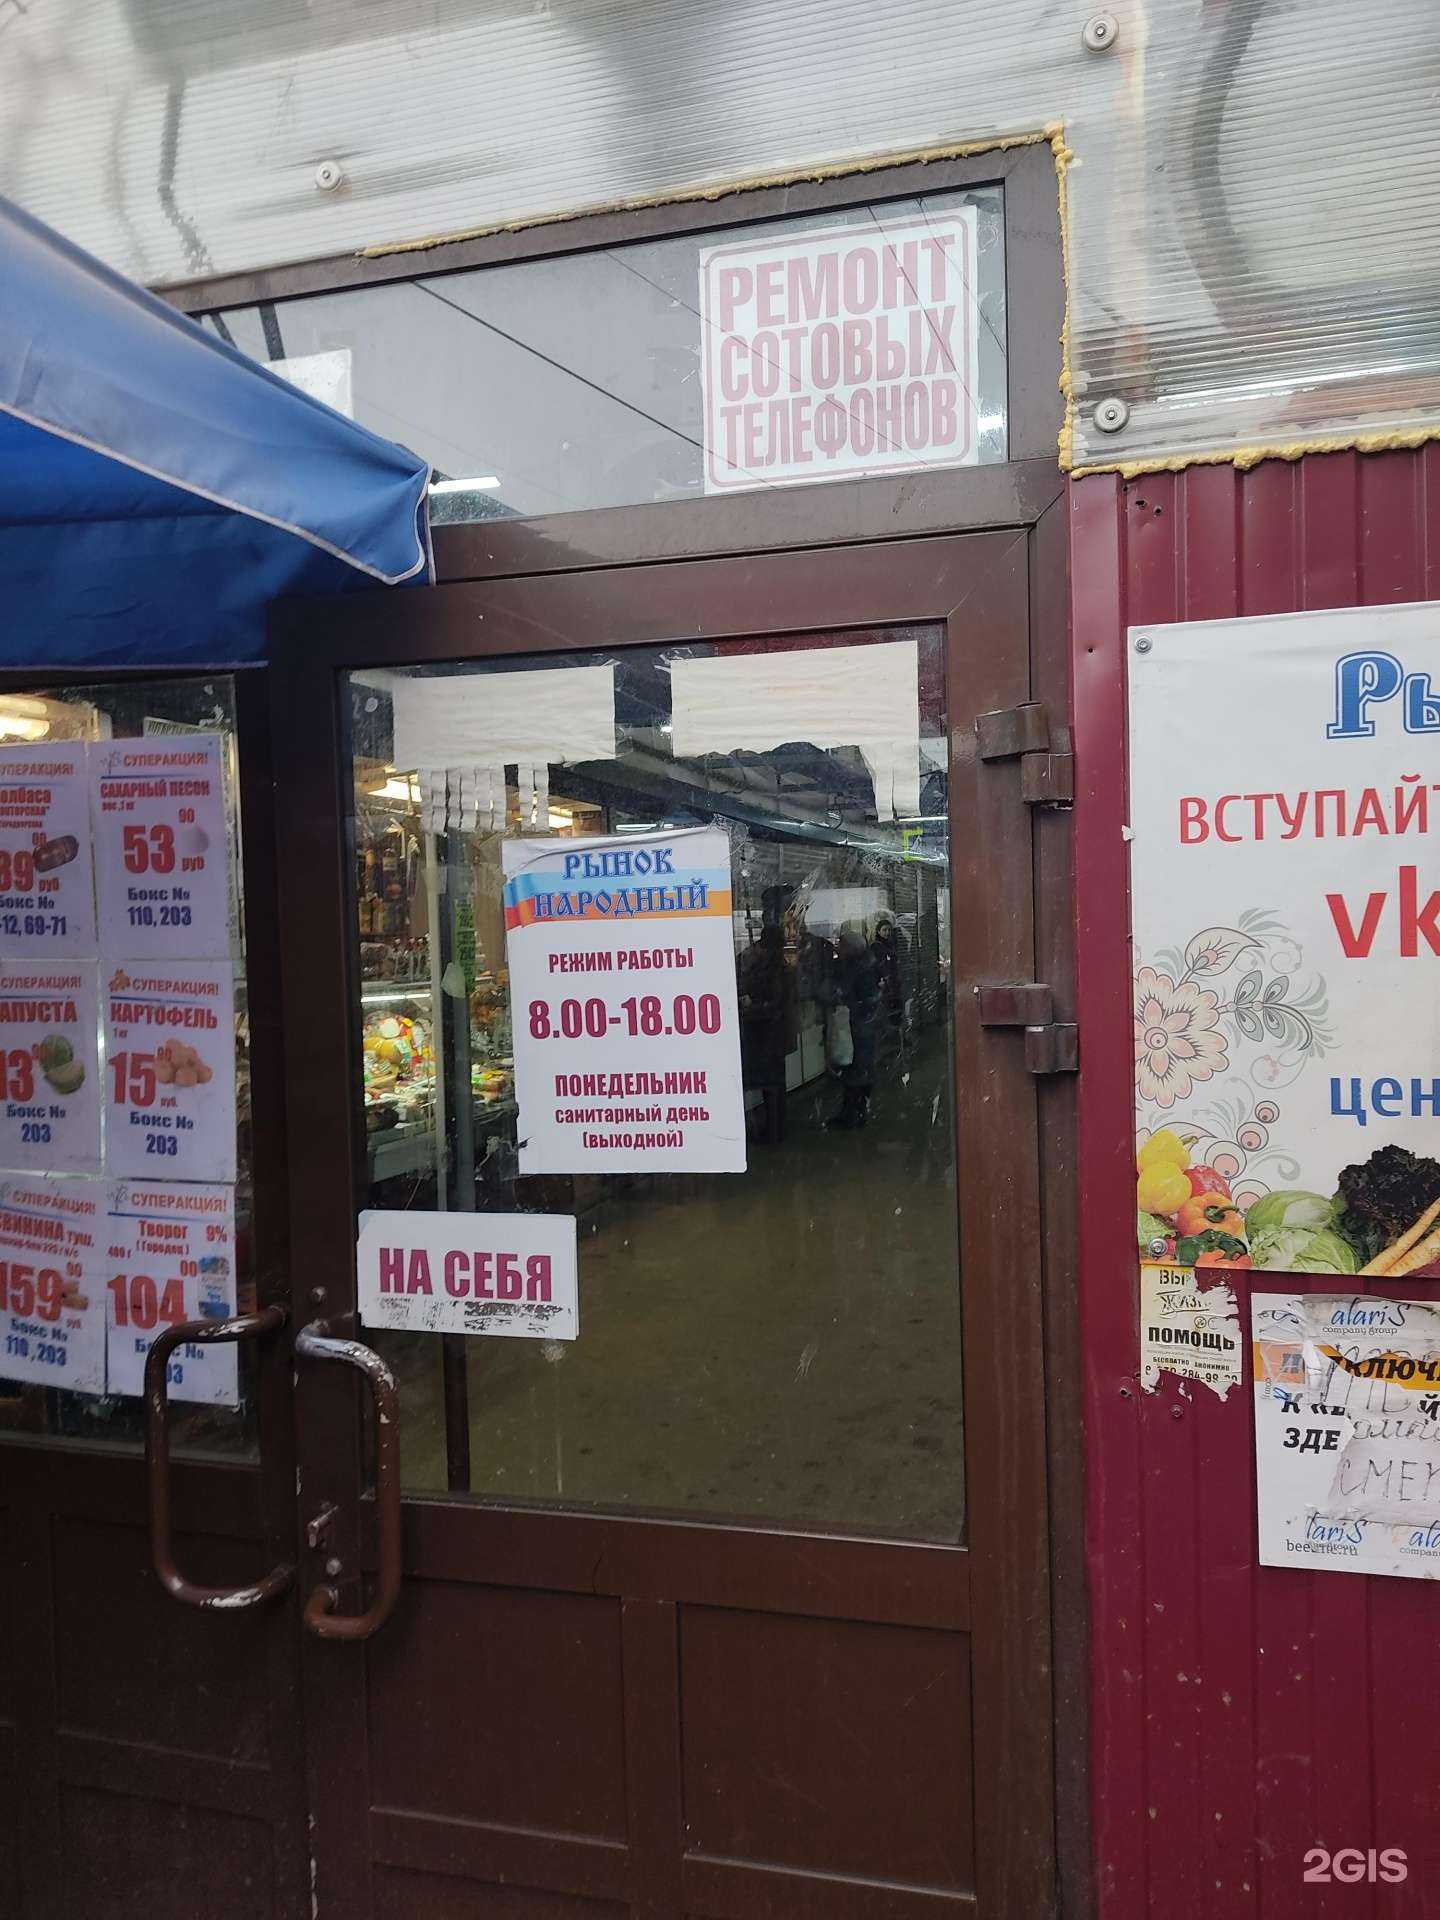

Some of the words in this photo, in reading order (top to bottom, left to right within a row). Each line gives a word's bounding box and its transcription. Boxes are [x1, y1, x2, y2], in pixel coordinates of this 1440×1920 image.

[719, 234, 955, 333] РЕМОНТ
[720, 305, 956, 402] СОТОВЫХ
[720, 379, 957, 470] ТЕЛЕФОНОВ
[123, 752, 208, 767] СУПЕРАКЦИЯ!
[101, 779, 166, 798] САХАРНЫЙ
[169, 780, 210, 797] ПЕСОК
[1178, 773, 1440, 844] ВСТУПАЙ
[123, 824, 176, 874] 53
[562, 848, 675, 880] РЫНОК
[127, 887, 168, 901] Бокс
[534, 878, 710, 917] НАРОДНЫЙ
[549, 951, 612, 973] РЕЖИМ
[617, 948, 694, 971] РАБОТЫ
[132, 978, 219, 996] СУПЕРАКЦИЯ!
[110, 1002, 218, 1029] КАРТОФЕЛЬ
[529, 993, 721, 1039] 8.00-18.00
[108, 1052, 156, 1107] 15
[555, 1071, 707, 1099] ПОНЕДЕЛЬНИК
[6, 1104, 46, 1118] Бокс
[129, 1111, 171, 1128] Бокс
[555, 1104, 662, 1124] санитарный
[666, 1106, 710, 1124] день
[21, 1123, 51, 1143] 203
[145, 1134, 178, 1156] 203
[131, 1192, 227, 1213] СУПЕРАКЦИЯ!
[138, 1219, 188, 1239] Творог
[180, 1260, 198, 1277] 00
[379, 1247, 433, 1295] НА
[444, 1250, 552, 1302] СЕБЯ
[107, 1273, 188, 1330] 104
[1148, 1327, 1235, 1351] ПОМОЩЬ
[1368, 1326, 1398, 1335] group
[1283, 1427, 1341, 1454] ЗДЕ
